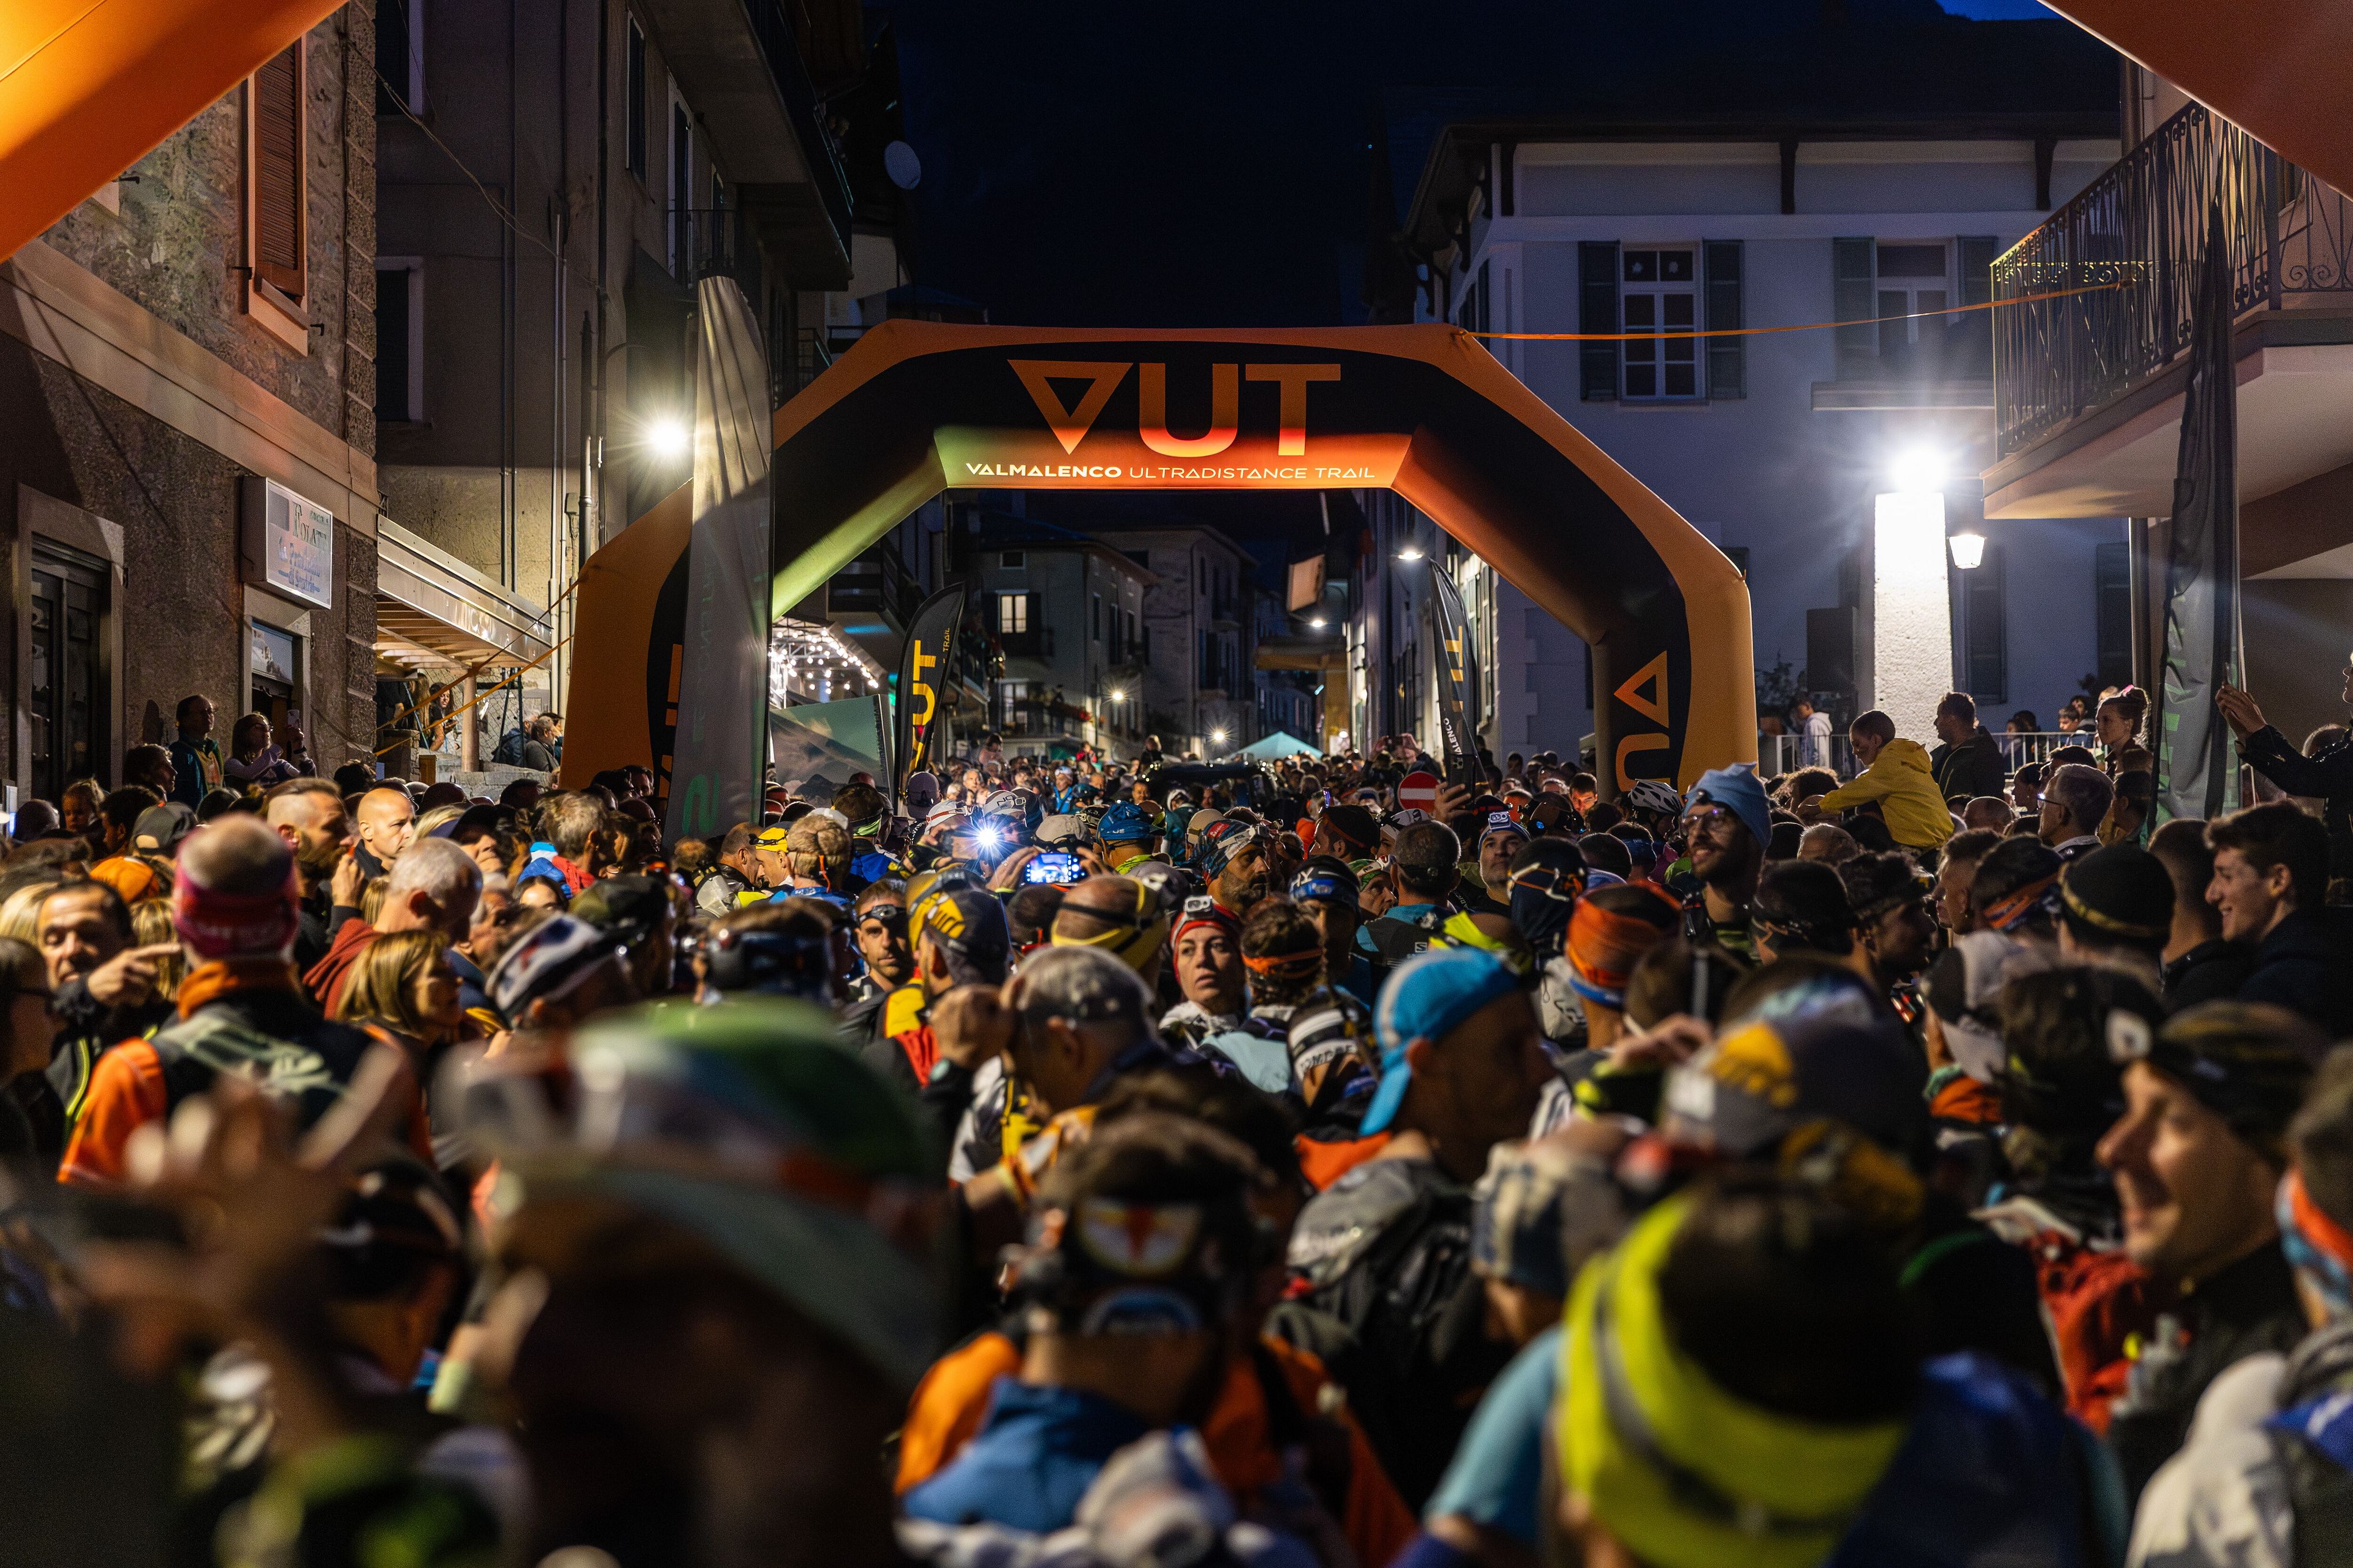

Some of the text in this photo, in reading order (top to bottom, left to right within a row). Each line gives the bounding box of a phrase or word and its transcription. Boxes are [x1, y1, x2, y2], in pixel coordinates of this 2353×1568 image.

[966, 463, 1375, 479] VALMALENCO ULTRADISTANCE TRAIL
[1614, 650, 1671, 792] VU
